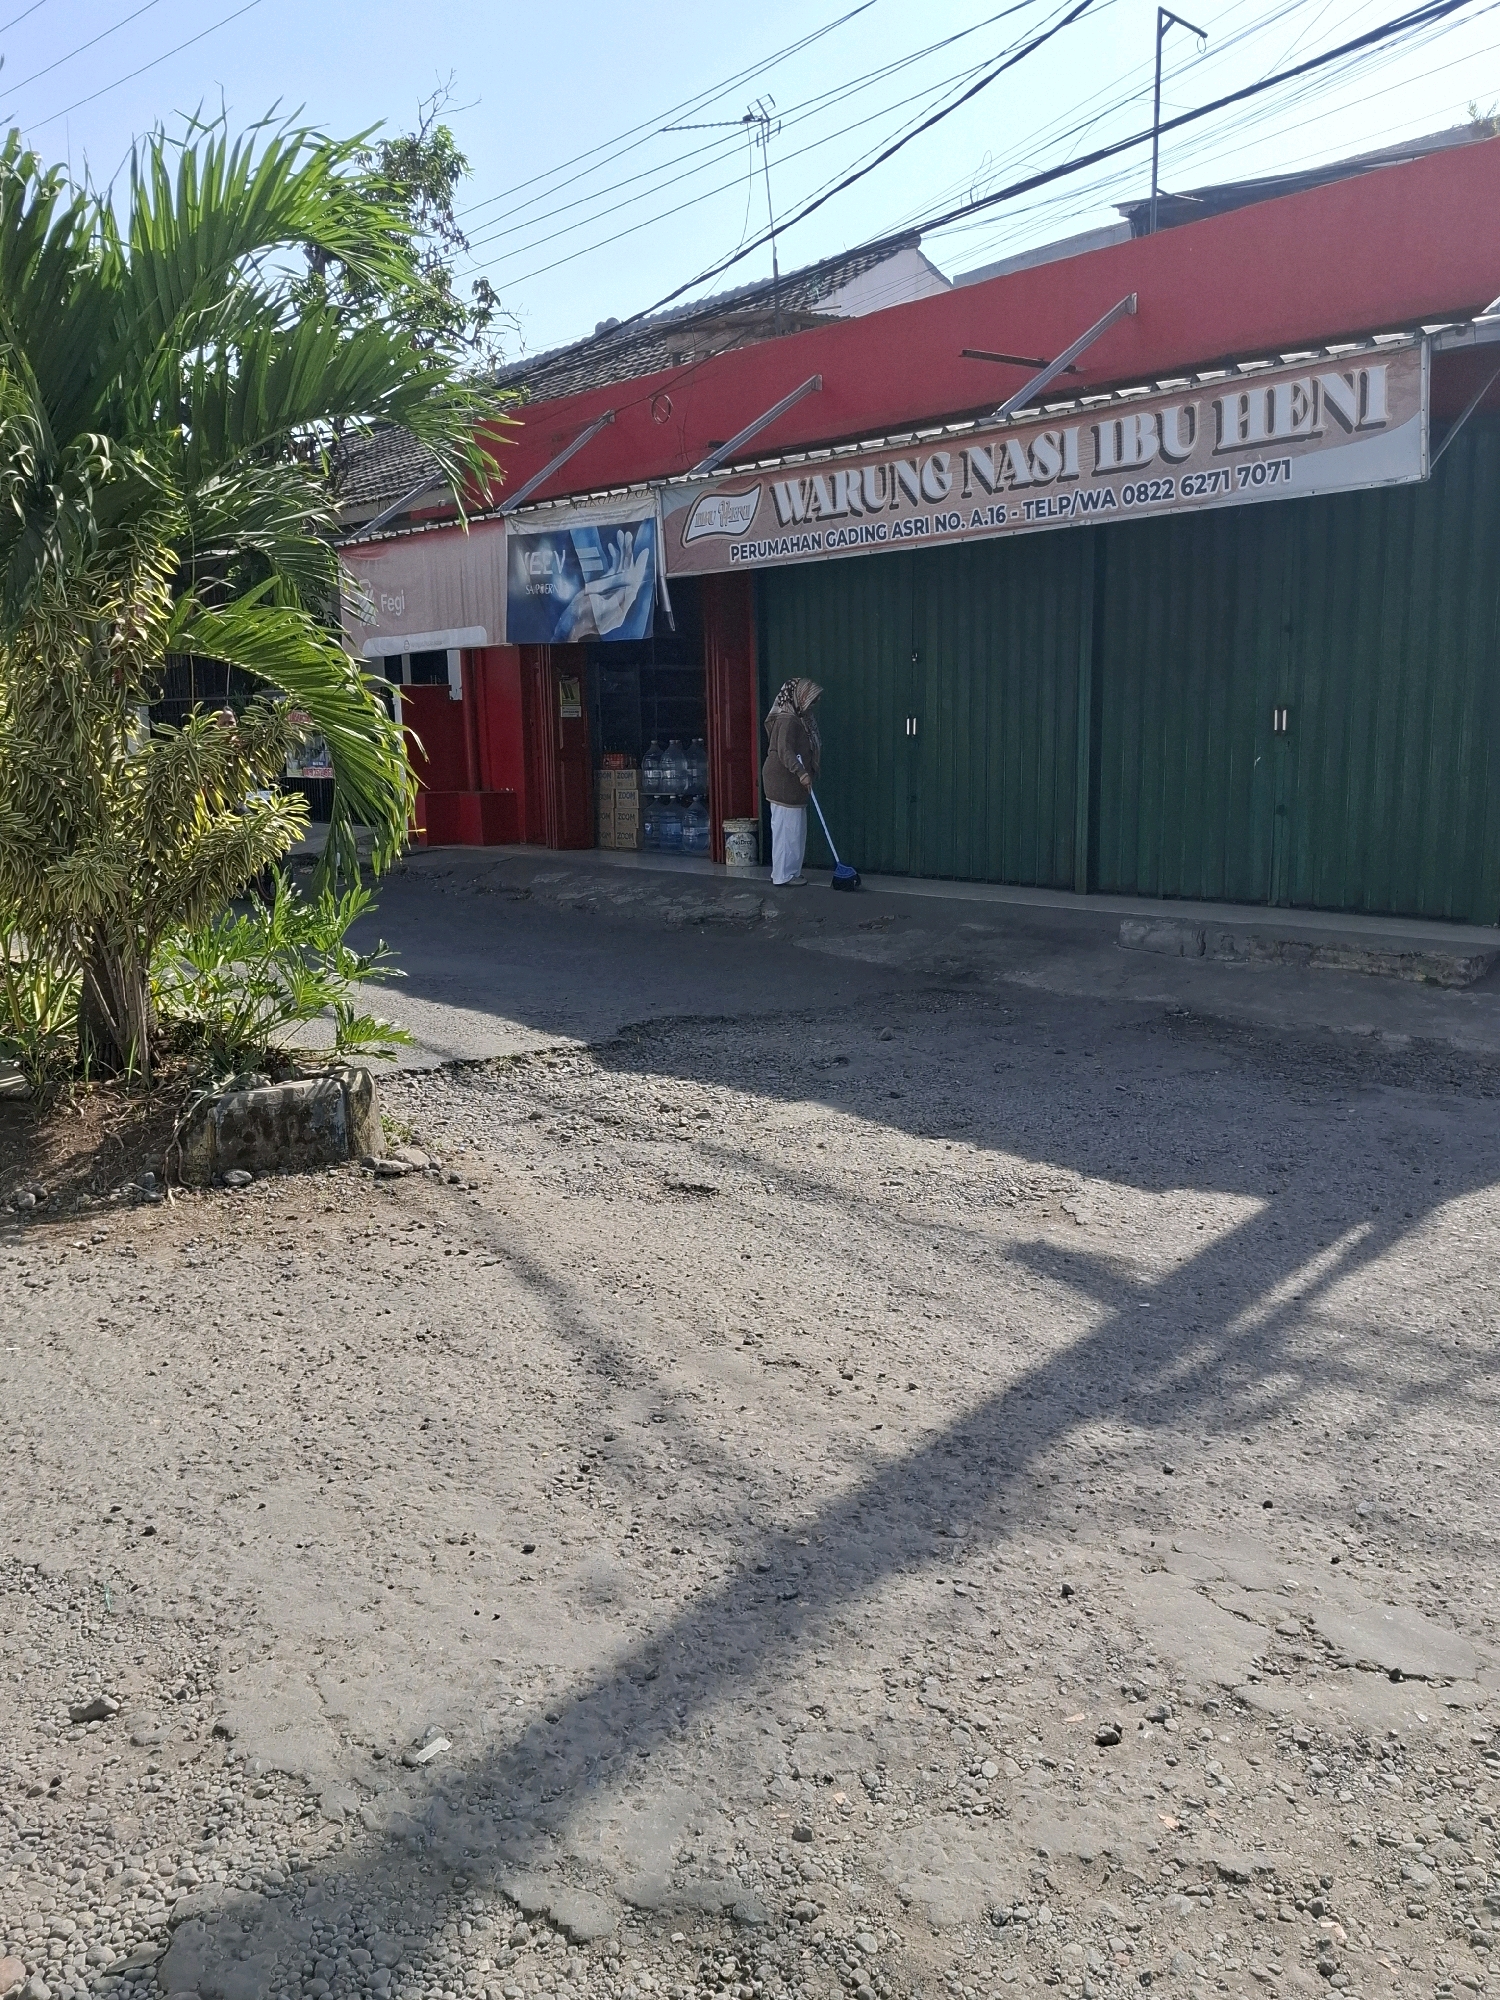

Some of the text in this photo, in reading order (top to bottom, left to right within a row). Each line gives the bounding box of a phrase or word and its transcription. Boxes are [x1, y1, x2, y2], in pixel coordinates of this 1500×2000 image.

[772, 362, 1394, 527] WARUNG NASI IBU HENI
[730, 531, 822, 562] PERUMAHAN
[826, 523, 887, 549] GADING
[892, 518, 930, 539] ASRI
[936, 512, 966, 532] NO.
[971, 505, 1006, 528] A.16
[1024, 489, 1117, 519] TELP/WA
[1122, 479, 1175, 505] 0822
[1180, 470, 1231, 497] 6271
[1236, 458, 1291, 488] 7071
[380, 589, 406, 617] Fegi
[616, 771, 634, 780] ZOOM
[617, 791, 636, 800] ZOOM
[617, 812, 636, 822] ZOOM
[616, 831, 635, 841] ZOOM
